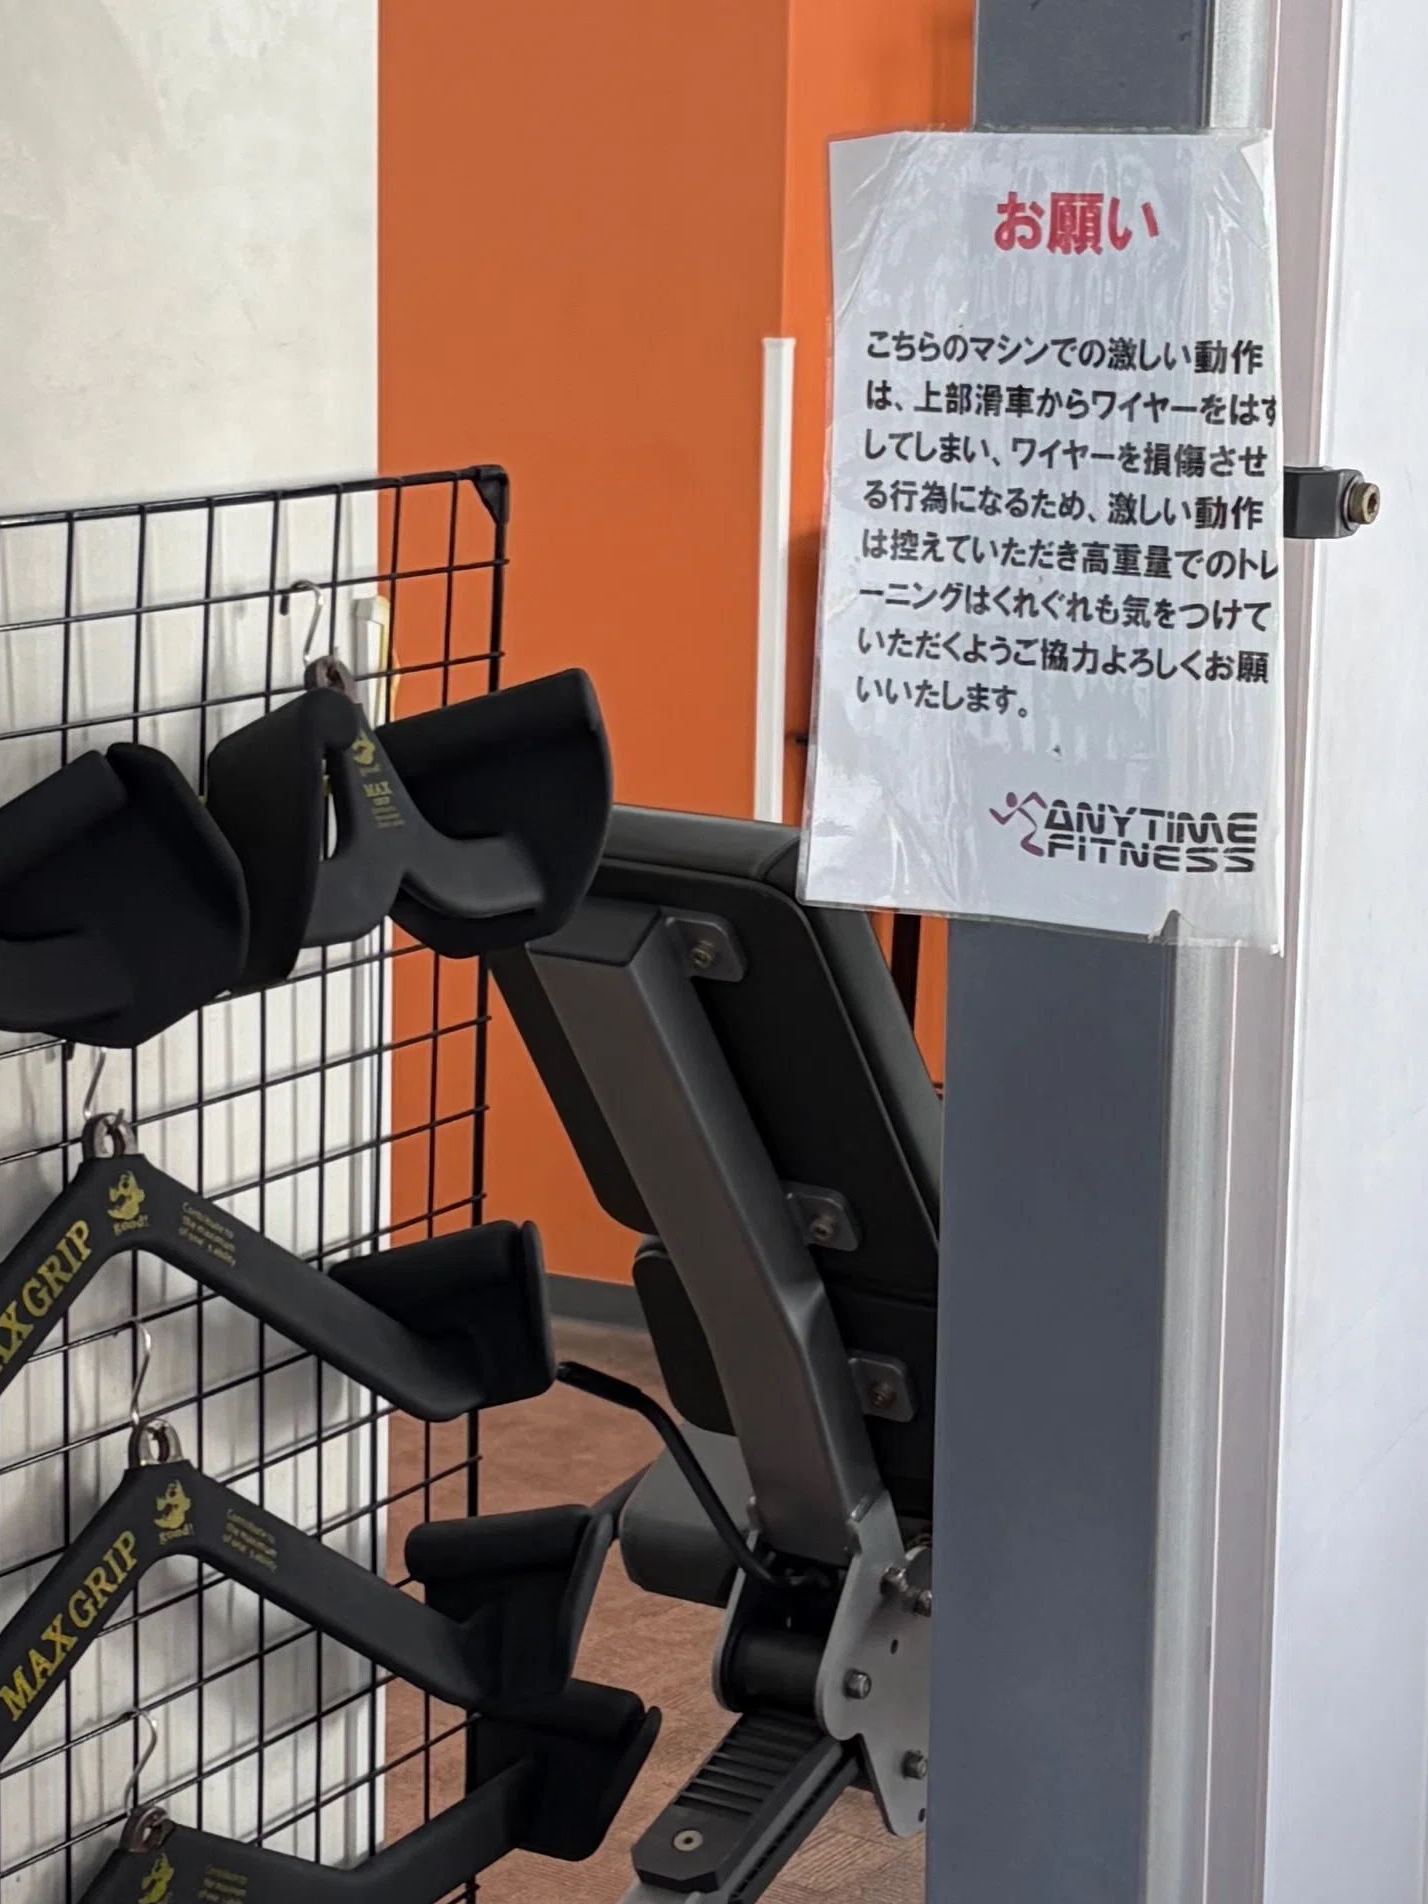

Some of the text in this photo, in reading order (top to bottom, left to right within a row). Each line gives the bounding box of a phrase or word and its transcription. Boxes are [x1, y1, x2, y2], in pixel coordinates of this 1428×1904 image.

[993, 191, 1160, 256] お願い
[866, 330, 1264, 375] こちらのマシンでの激しい動作
[864, 428, 1268, 477] してしまい、ワイヤーを損傷させ
[863, 480, 1264, 530] る行為になるため、激しい動作
[861, 528, 1278, 581] は控えていただき高重量でのトレ
[859, 582, 1272, 632] ーニングはくれぐれも気をつけて
[858, 627, 1270, 684] いただくようご協力よろしくお願
[856, 675, 1028, 718] いいたします。
[1044, 799, 1258, 844] ANYTIME
[1047, 833, 1257, 873] FITNESS
[21, 1219, 92, 1321] GRIP
[68, 1530, 138, 1634] GRIP
